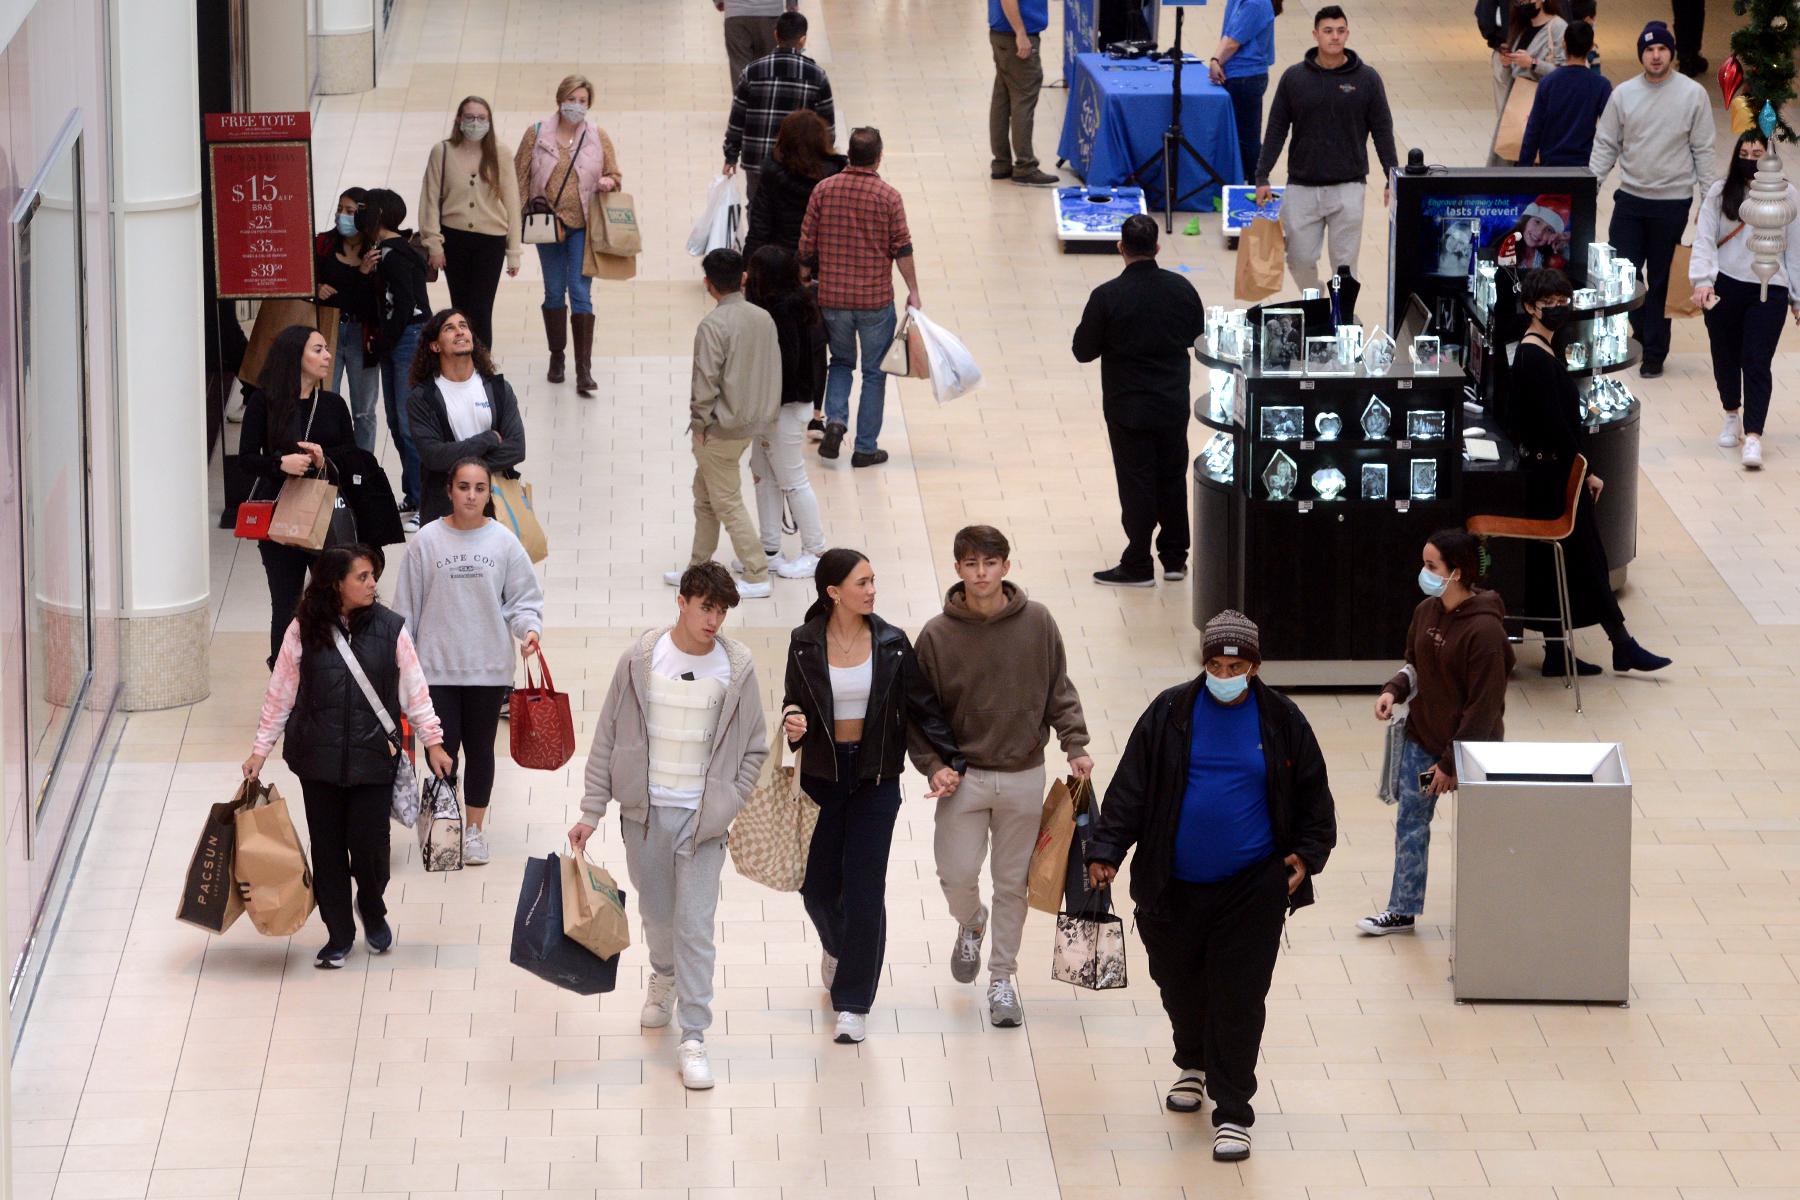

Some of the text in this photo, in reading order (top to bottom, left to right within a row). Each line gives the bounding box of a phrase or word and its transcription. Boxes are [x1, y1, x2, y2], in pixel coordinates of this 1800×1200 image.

[221, 114, 296, 128] FREE TOTE
[231, 174, 278, 203] $15
[1446, 206, 1519, 216] lasts forever!
[249, 215, 272, 229] $25
[250, 239, 273, 252] $35
[436, 554, 467, 569] CAPE
[473, 554, 495, 568] COD
[197, 834, 218, 905] PACSUN
